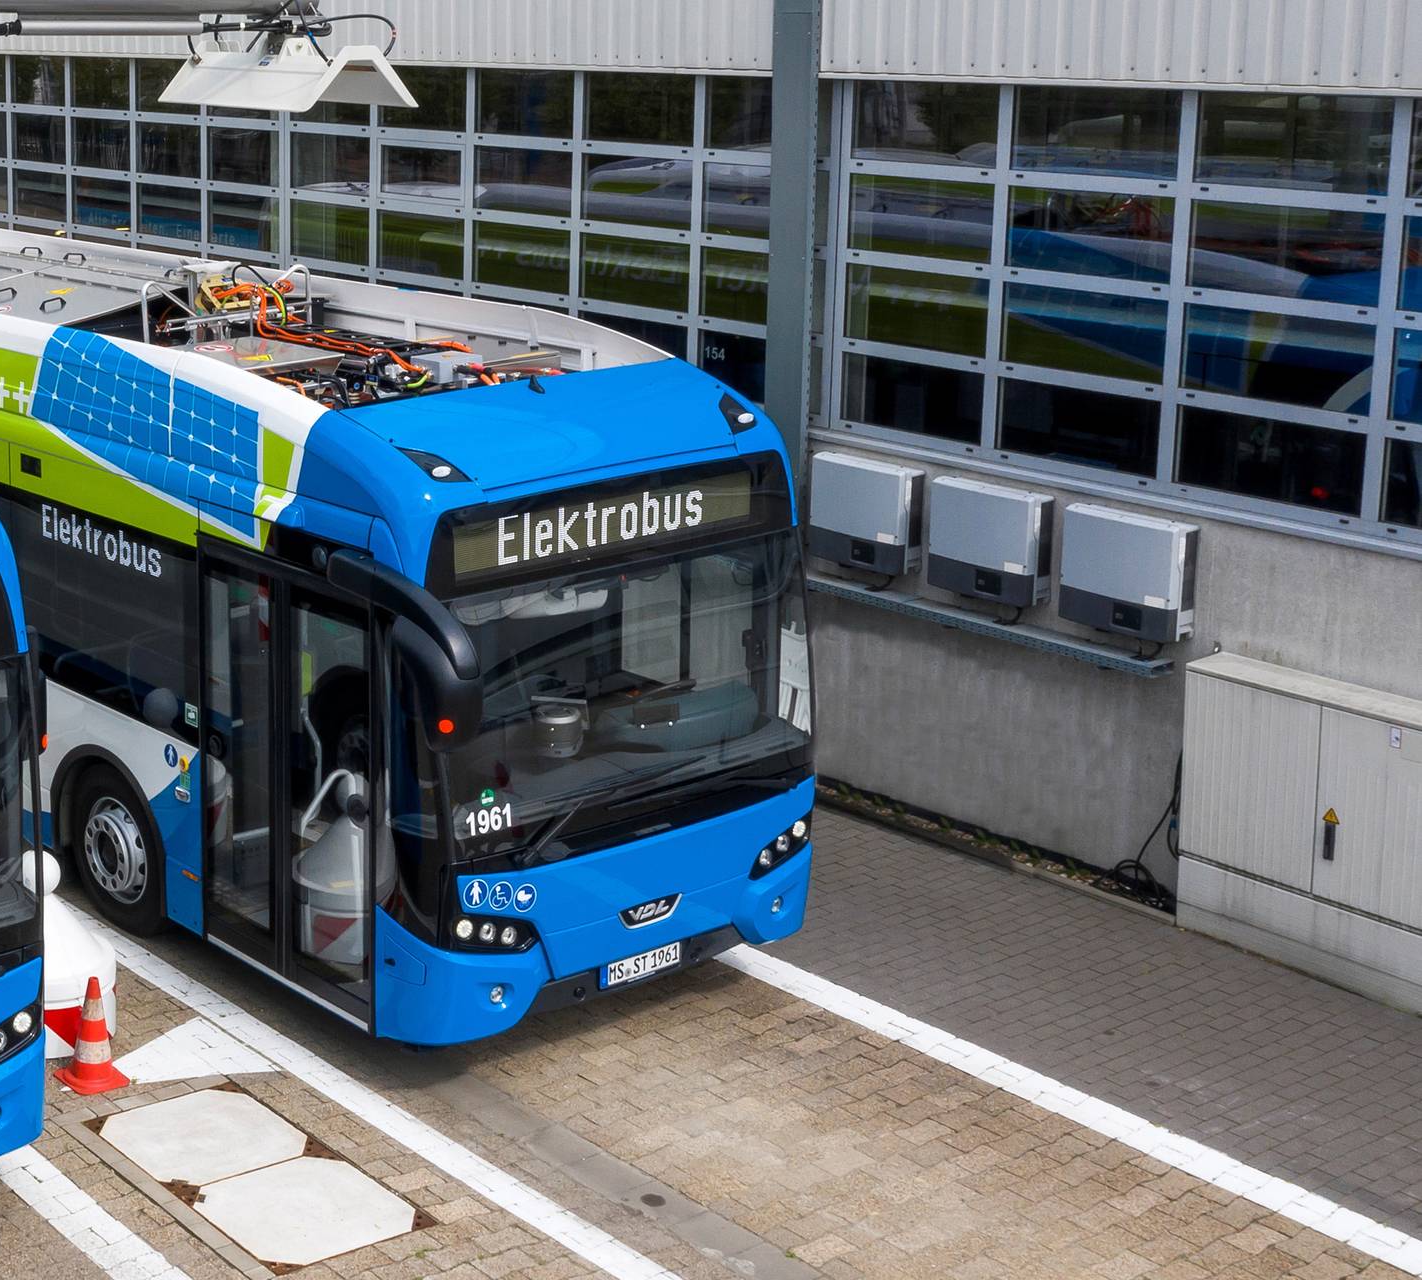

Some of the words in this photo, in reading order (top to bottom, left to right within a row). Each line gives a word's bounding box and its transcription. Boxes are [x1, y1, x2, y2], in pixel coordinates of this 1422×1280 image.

[705, 346, 726, 361] 154
[41, 503, 162, 578] Elektrobus
[497, 489, 704, 566] Elektrobus
[465, 802, 512, 836] 1961
[628, 899, 670, 921] VDL
[608, 962, 624, 982] MS
[633, 955, 648, 974] ST
[651, 944, 679, 969] 1961
